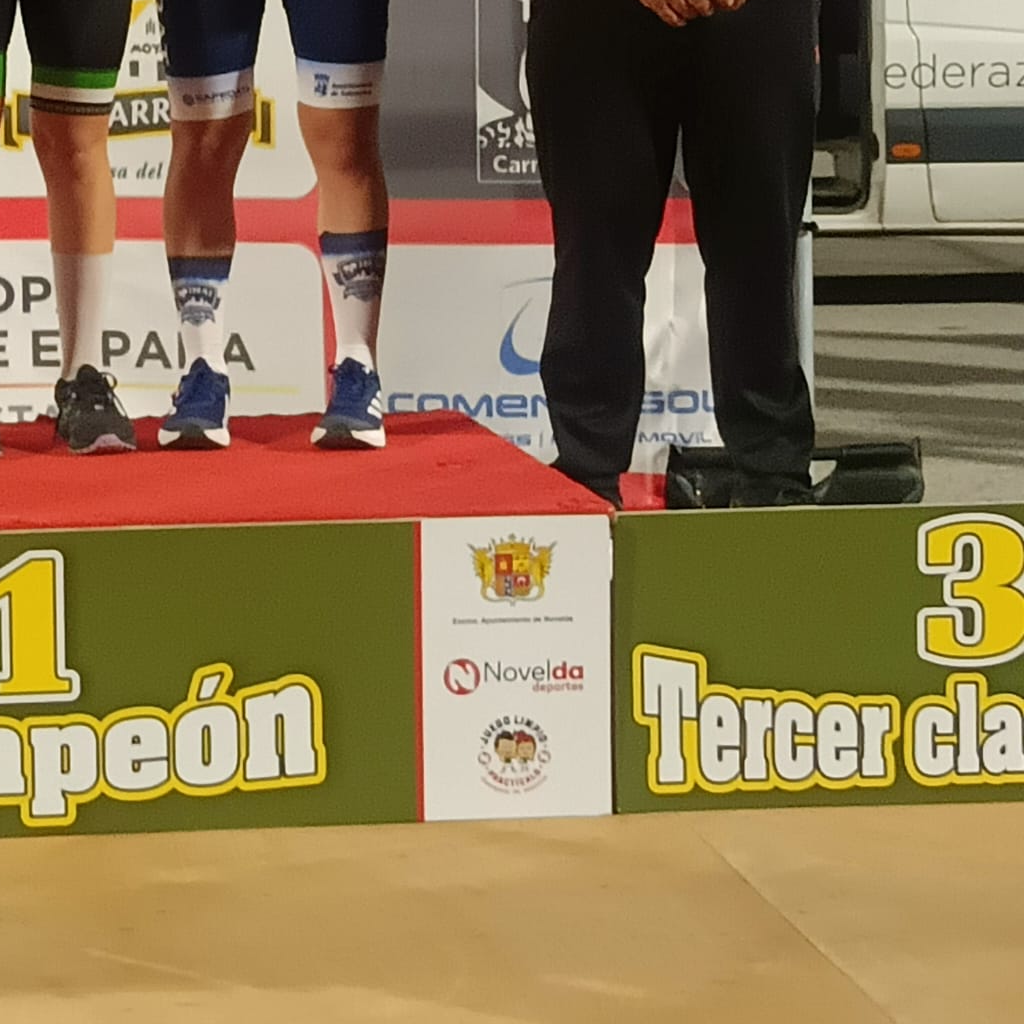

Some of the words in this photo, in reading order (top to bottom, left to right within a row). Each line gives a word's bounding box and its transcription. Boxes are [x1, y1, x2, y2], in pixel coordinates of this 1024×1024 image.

[882, 53, 1024, 90] edera
[136, 162, 164, 180] del
[916, 512, 1024, 668] 3
[483, 658, 584, 683] Novelda
[632, 643, 901, 794] Tercer
[904, 672, 1024, 787] cla
